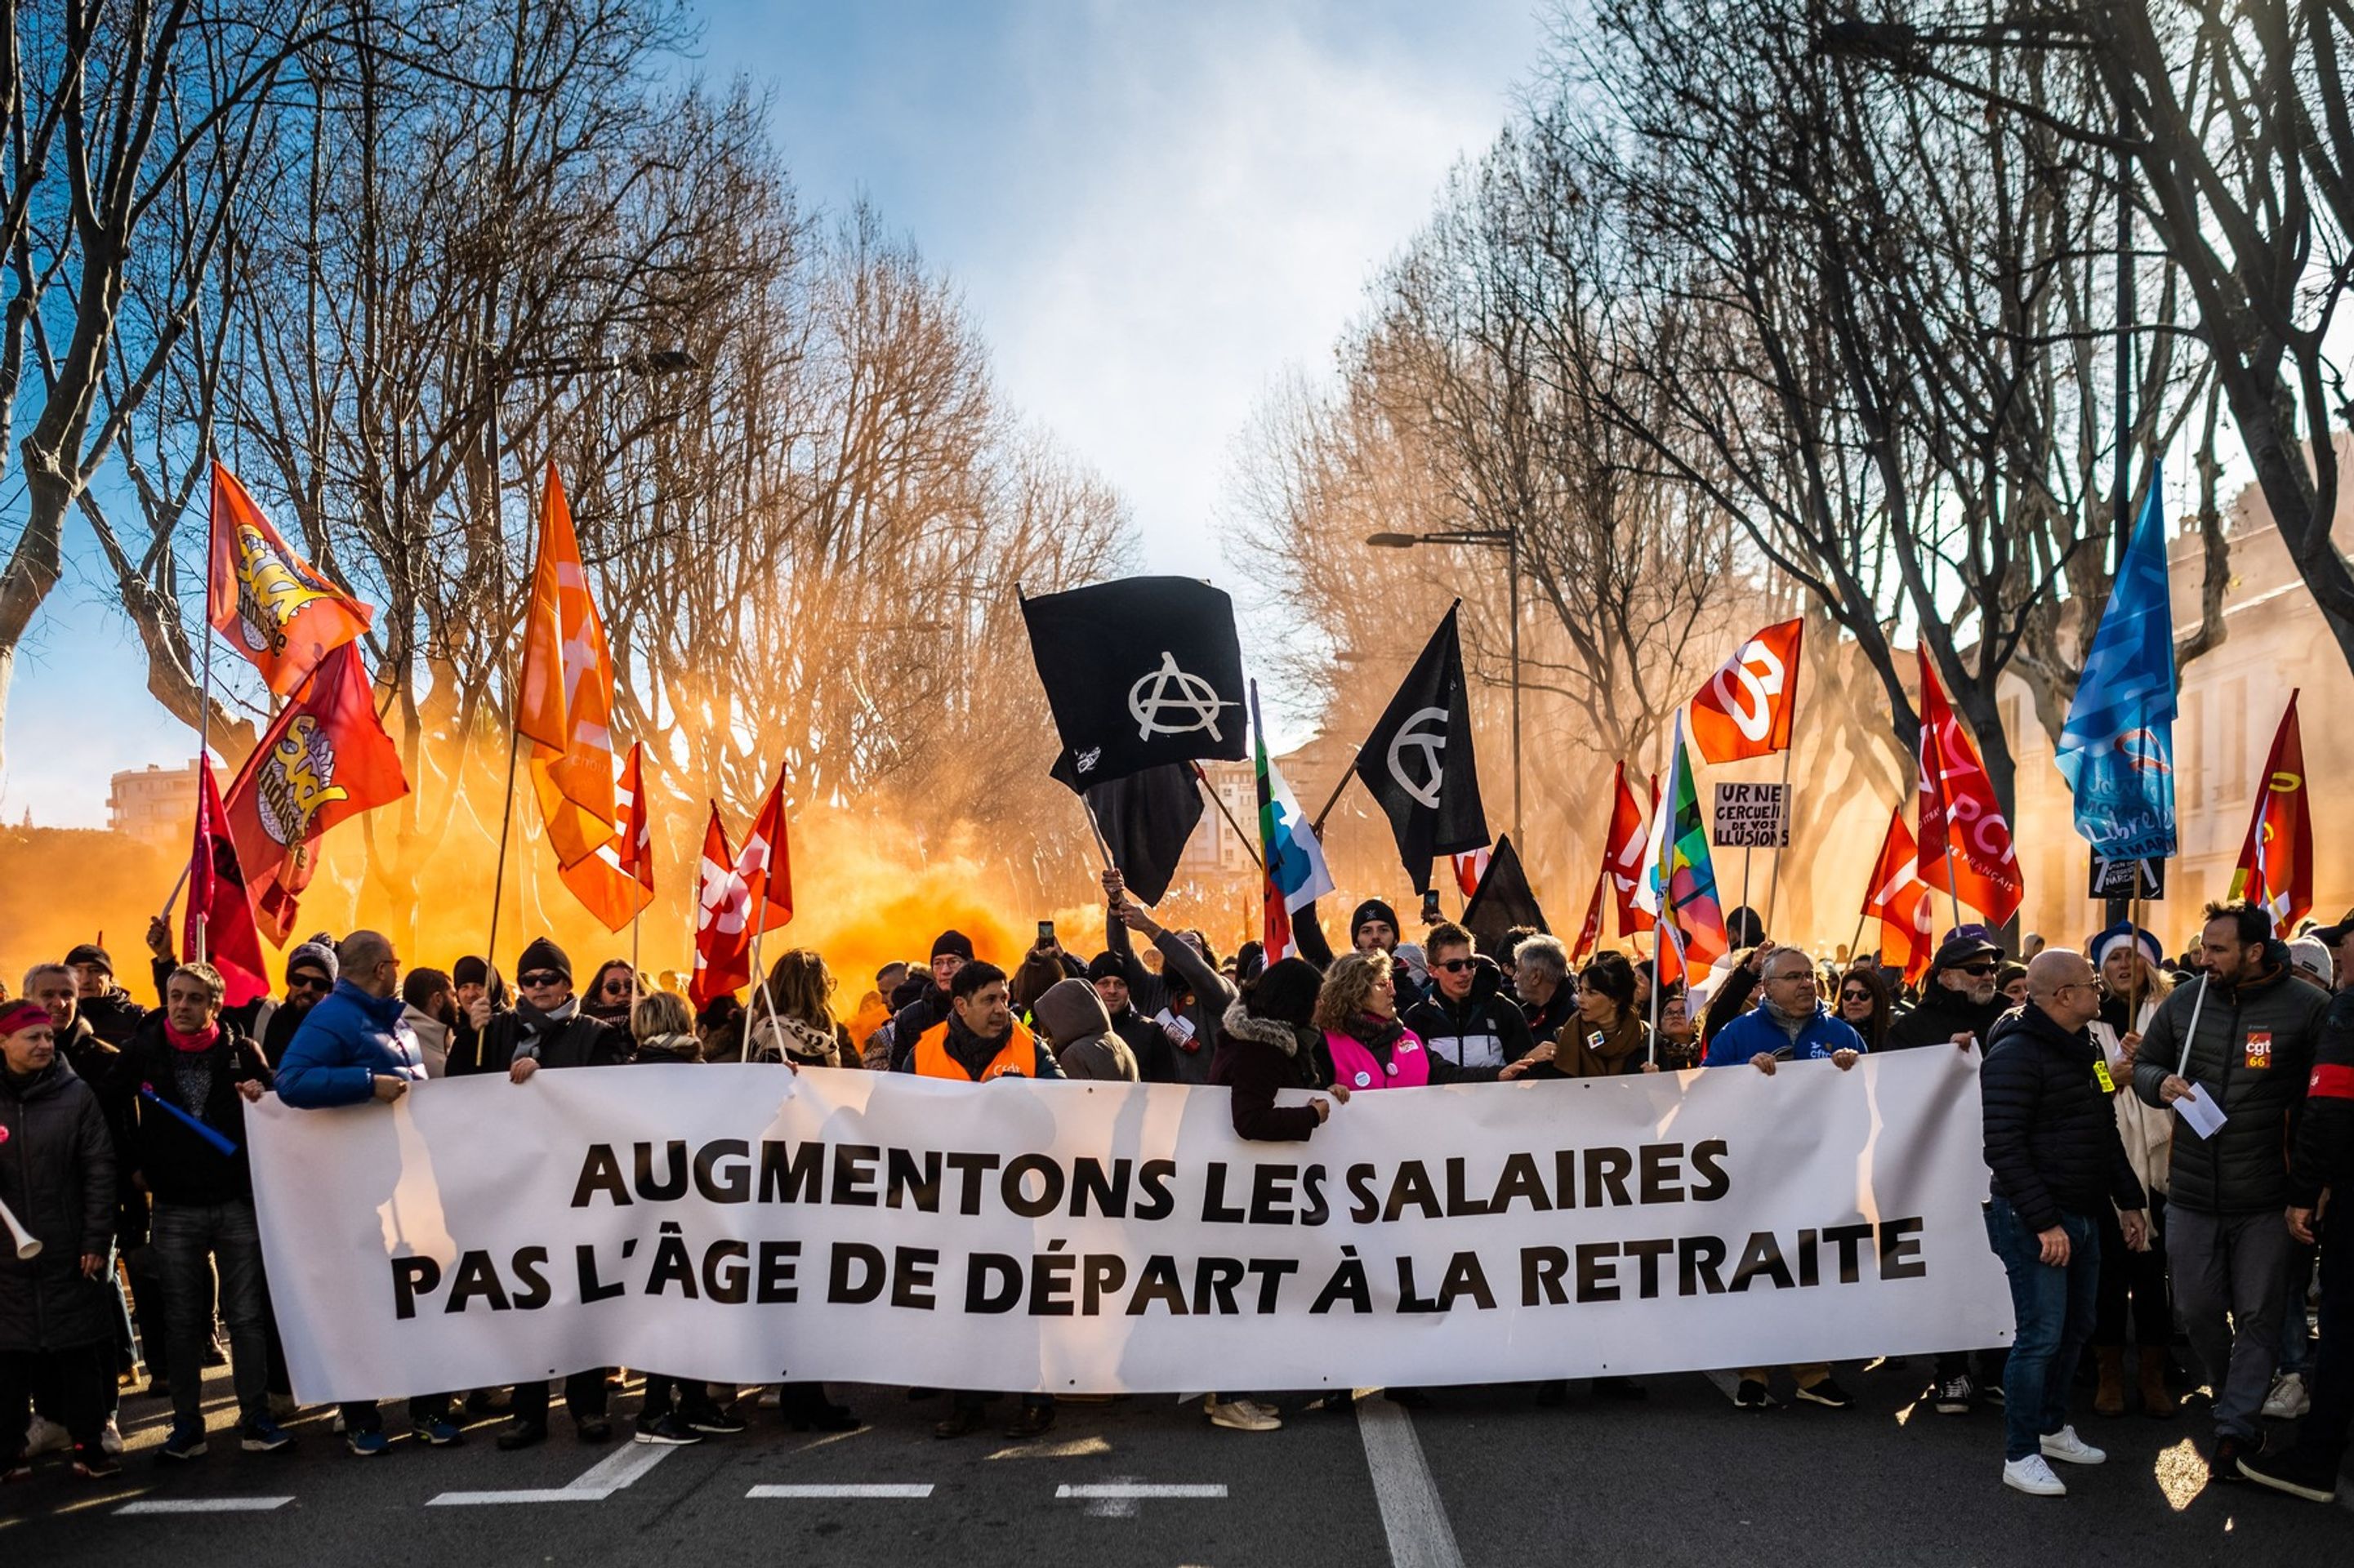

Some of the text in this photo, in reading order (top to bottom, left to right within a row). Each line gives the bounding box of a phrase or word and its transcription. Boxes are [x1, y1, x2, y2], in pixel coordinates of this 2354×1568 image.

[1722, 784, 1784, 803] URNE
[1732, 820, 1777, 831] DE VOS
[1962, 849, 2015, 893] FRANÇAIS
[2246, 1040, 2271, 1056] cgt
[2249, 1056, 2266, 1067] 66
[571, 1138, 1730, 1227] AUGMENTONS LES SALAIRES
[390, 1216, 1927, 1320] PAS L'ÂGE DE DÉPART À LA RETRAITE
